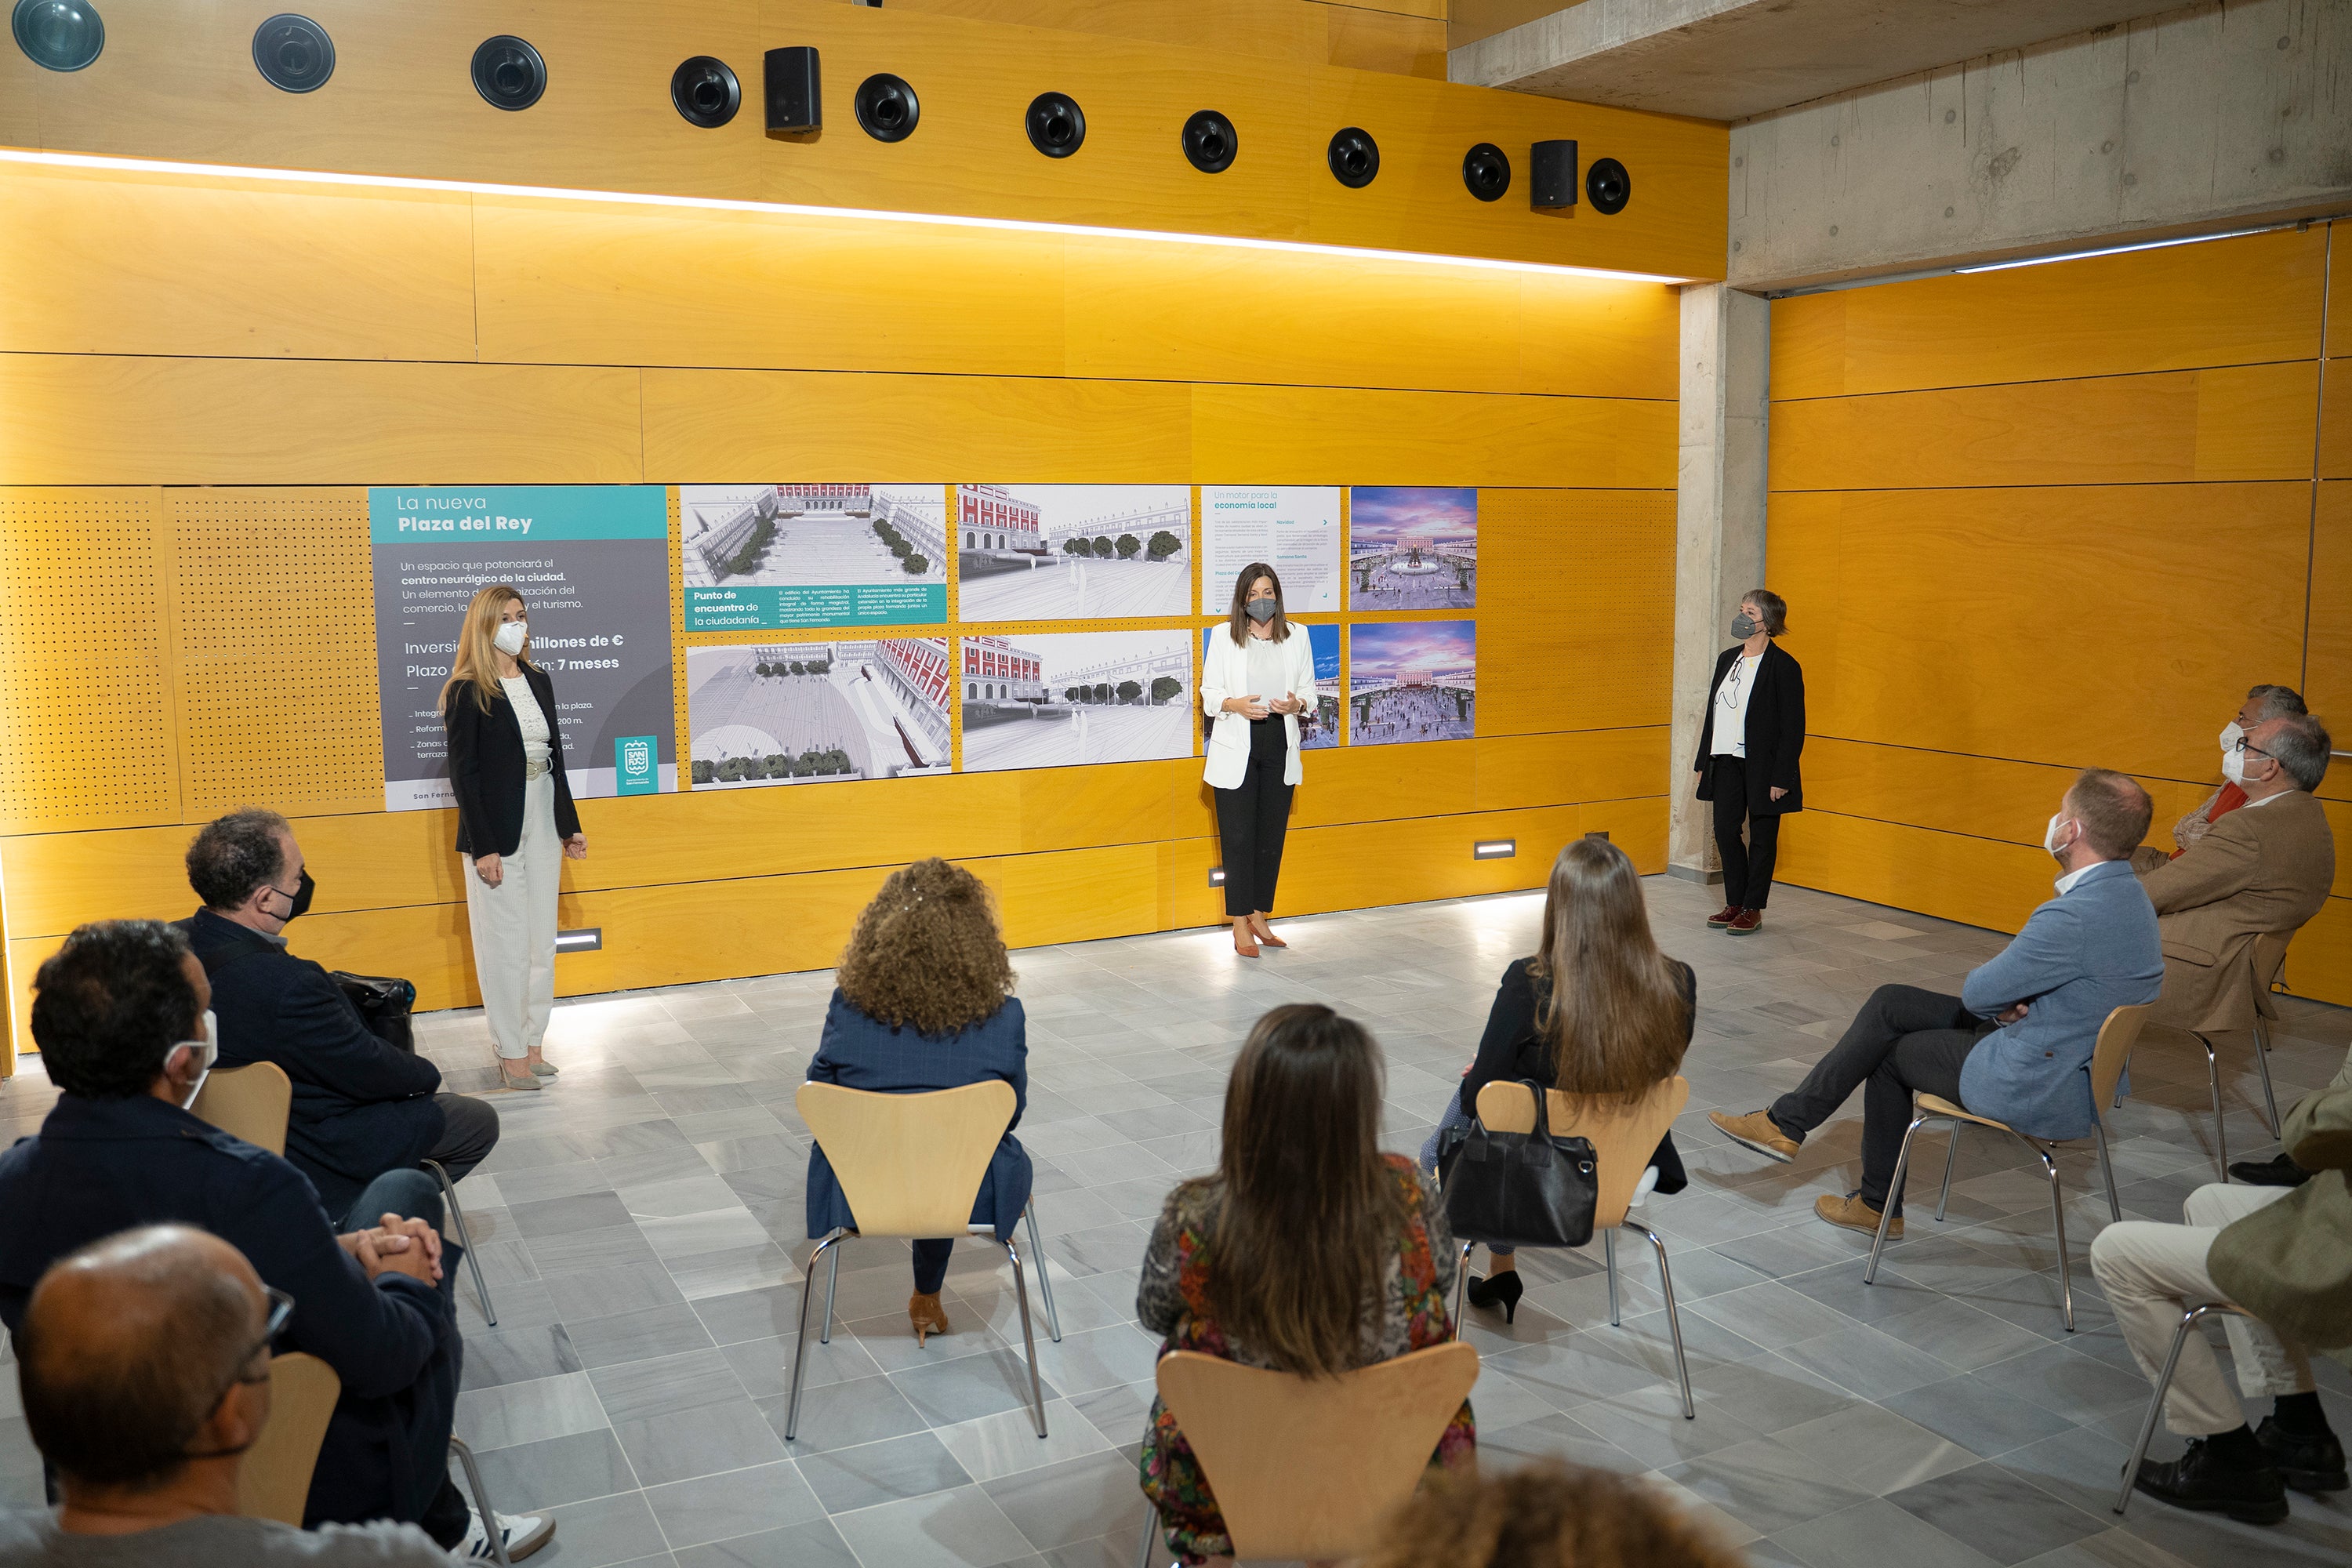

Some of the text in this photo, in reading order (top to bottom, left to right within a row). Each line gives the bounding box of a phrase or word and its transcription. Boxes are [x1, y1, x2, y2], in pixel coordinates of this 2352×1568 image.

[397, 495, 486, 510] La nueva
[1214, 500, 1255, 509] economía
[398, 516, 532, 535] Plaza del Rey
[401, 559, 554, 572] Un espacio que potenciará el
[401, 572, 566, 586] centro neurálgico de la ciudad.
[419, 590, 470, 599] elemento
[560, 586, 575, 594] del
[458, 603, 467, 612] la
[543, 600, 583, 608] turismo.
[695, 603, 758, 613] encuentro de
[706, 615, 760, 626] ciudadanía
[405, 634, 624, 654] Inversi illones de €
[407, 665, 447, 677] Plazo
[557, 659, 565, 670] 7
[569, 659, 619, 670] meses
[571, 702, 593, 711] plaza.
